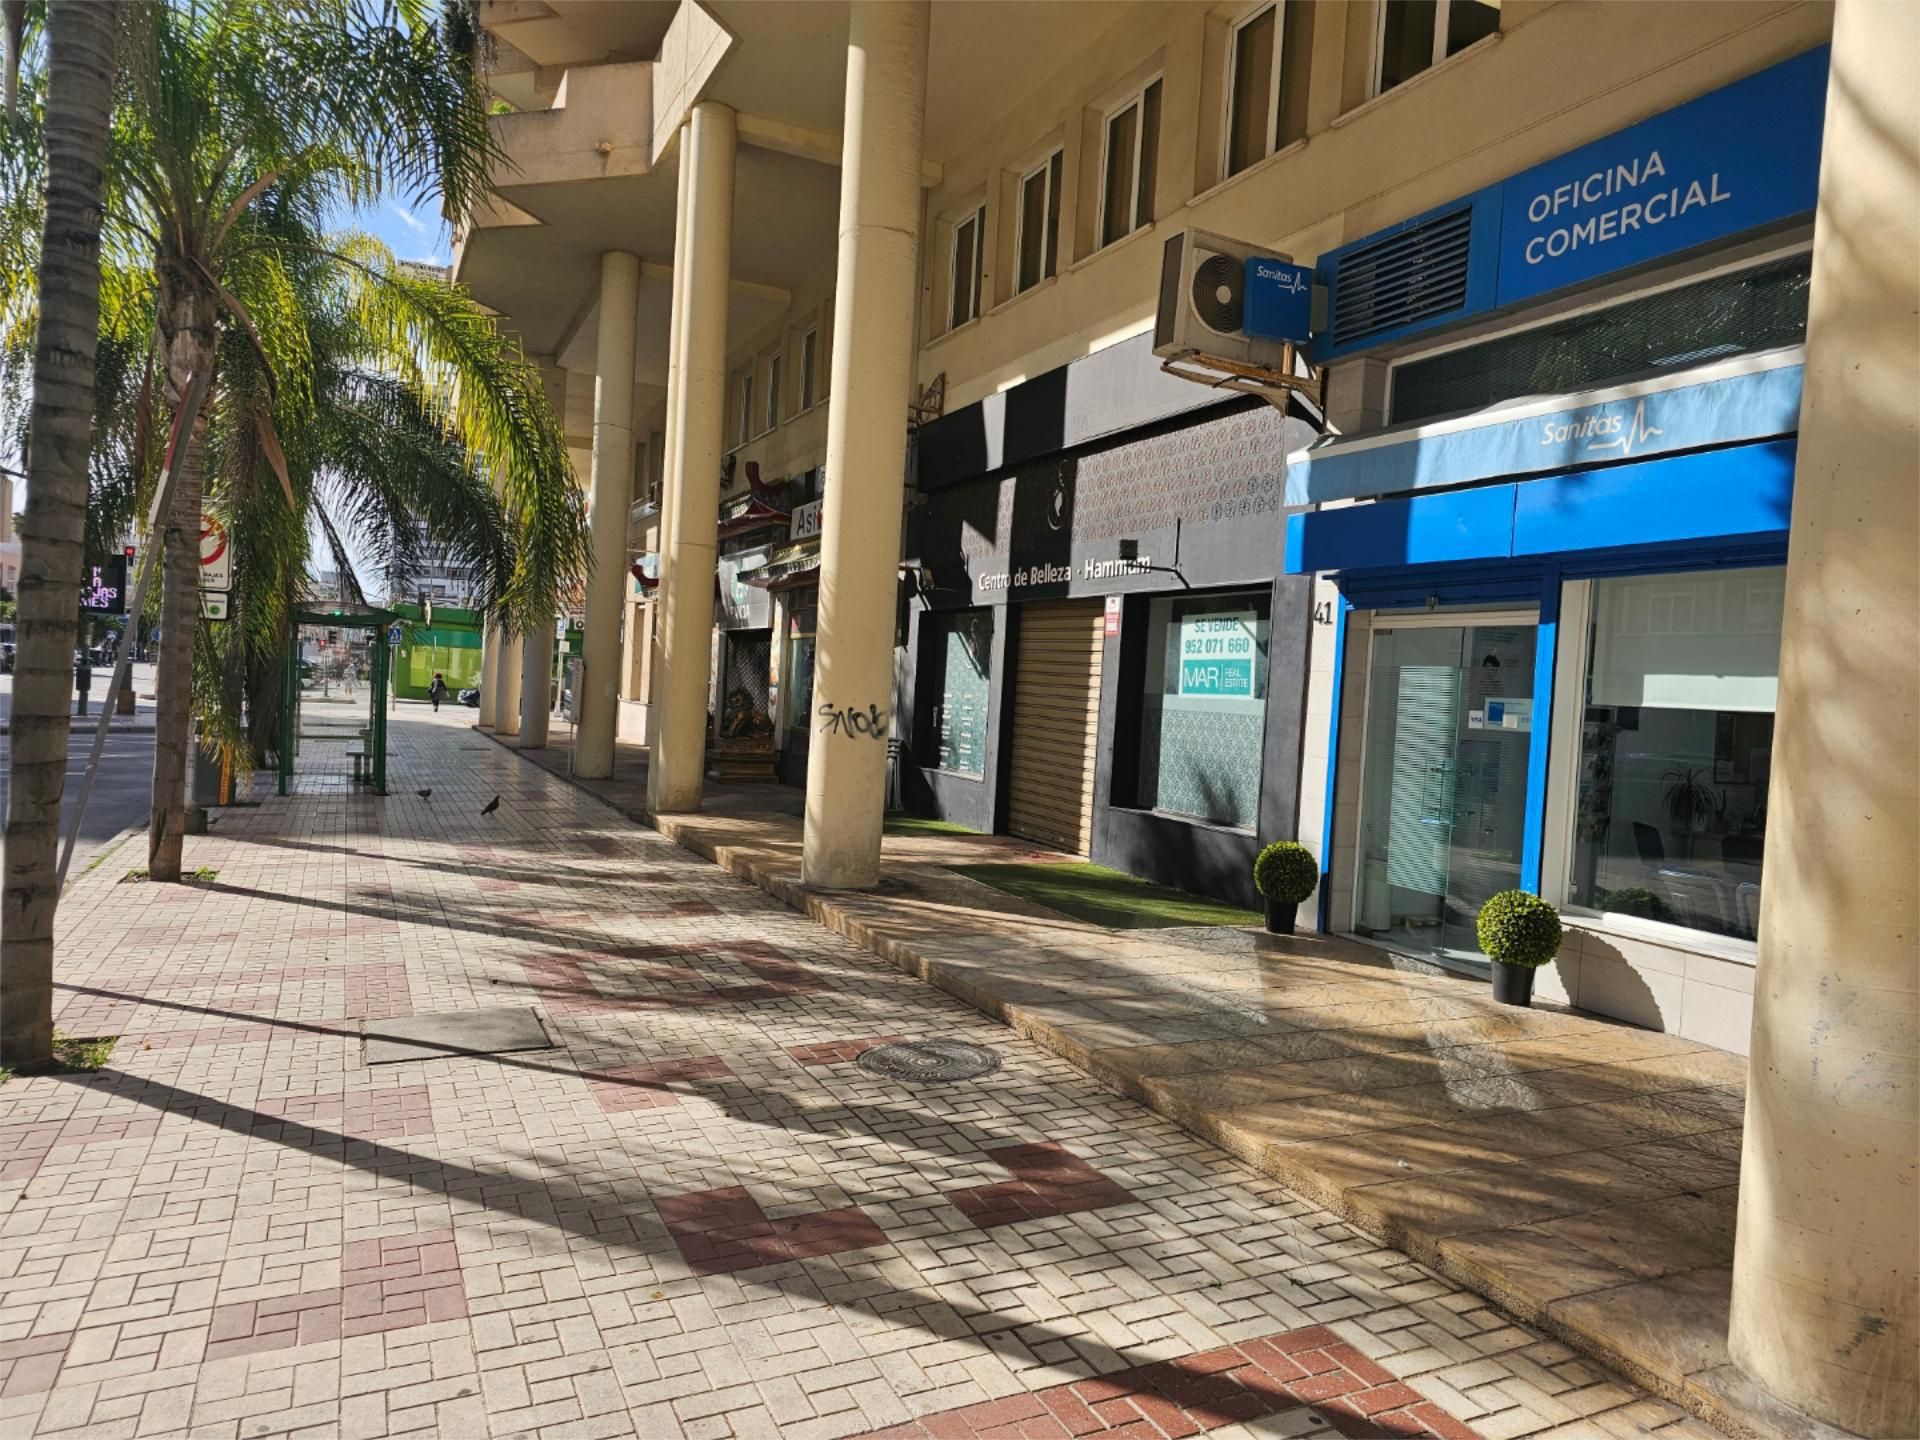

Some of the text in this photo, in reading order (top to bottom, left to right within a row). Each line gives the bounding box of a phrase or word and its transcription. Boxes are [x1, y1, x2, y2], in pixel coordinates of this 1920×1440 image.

[1527, 151, 1666, 223] OFICINA
[1524, 173, 1732, 265] COMERCIAL
[1256, 265, 1293, 283] Sanitas
[1540, 415, 1622, 446] Sanitas
[978, 555, 1153, 592] Centro de Belleza Hammam
[1313, 601, 1333, 625] 41
[1194, 617, 1239, 633] SE VENDE
[1185, 637, 1250, 654] 952 071 660
[1183, 666, 1220, 689] MAR
[1224, 667, 1242, 677] REAL
[1224, 678, 1249, 688] ESTATE
